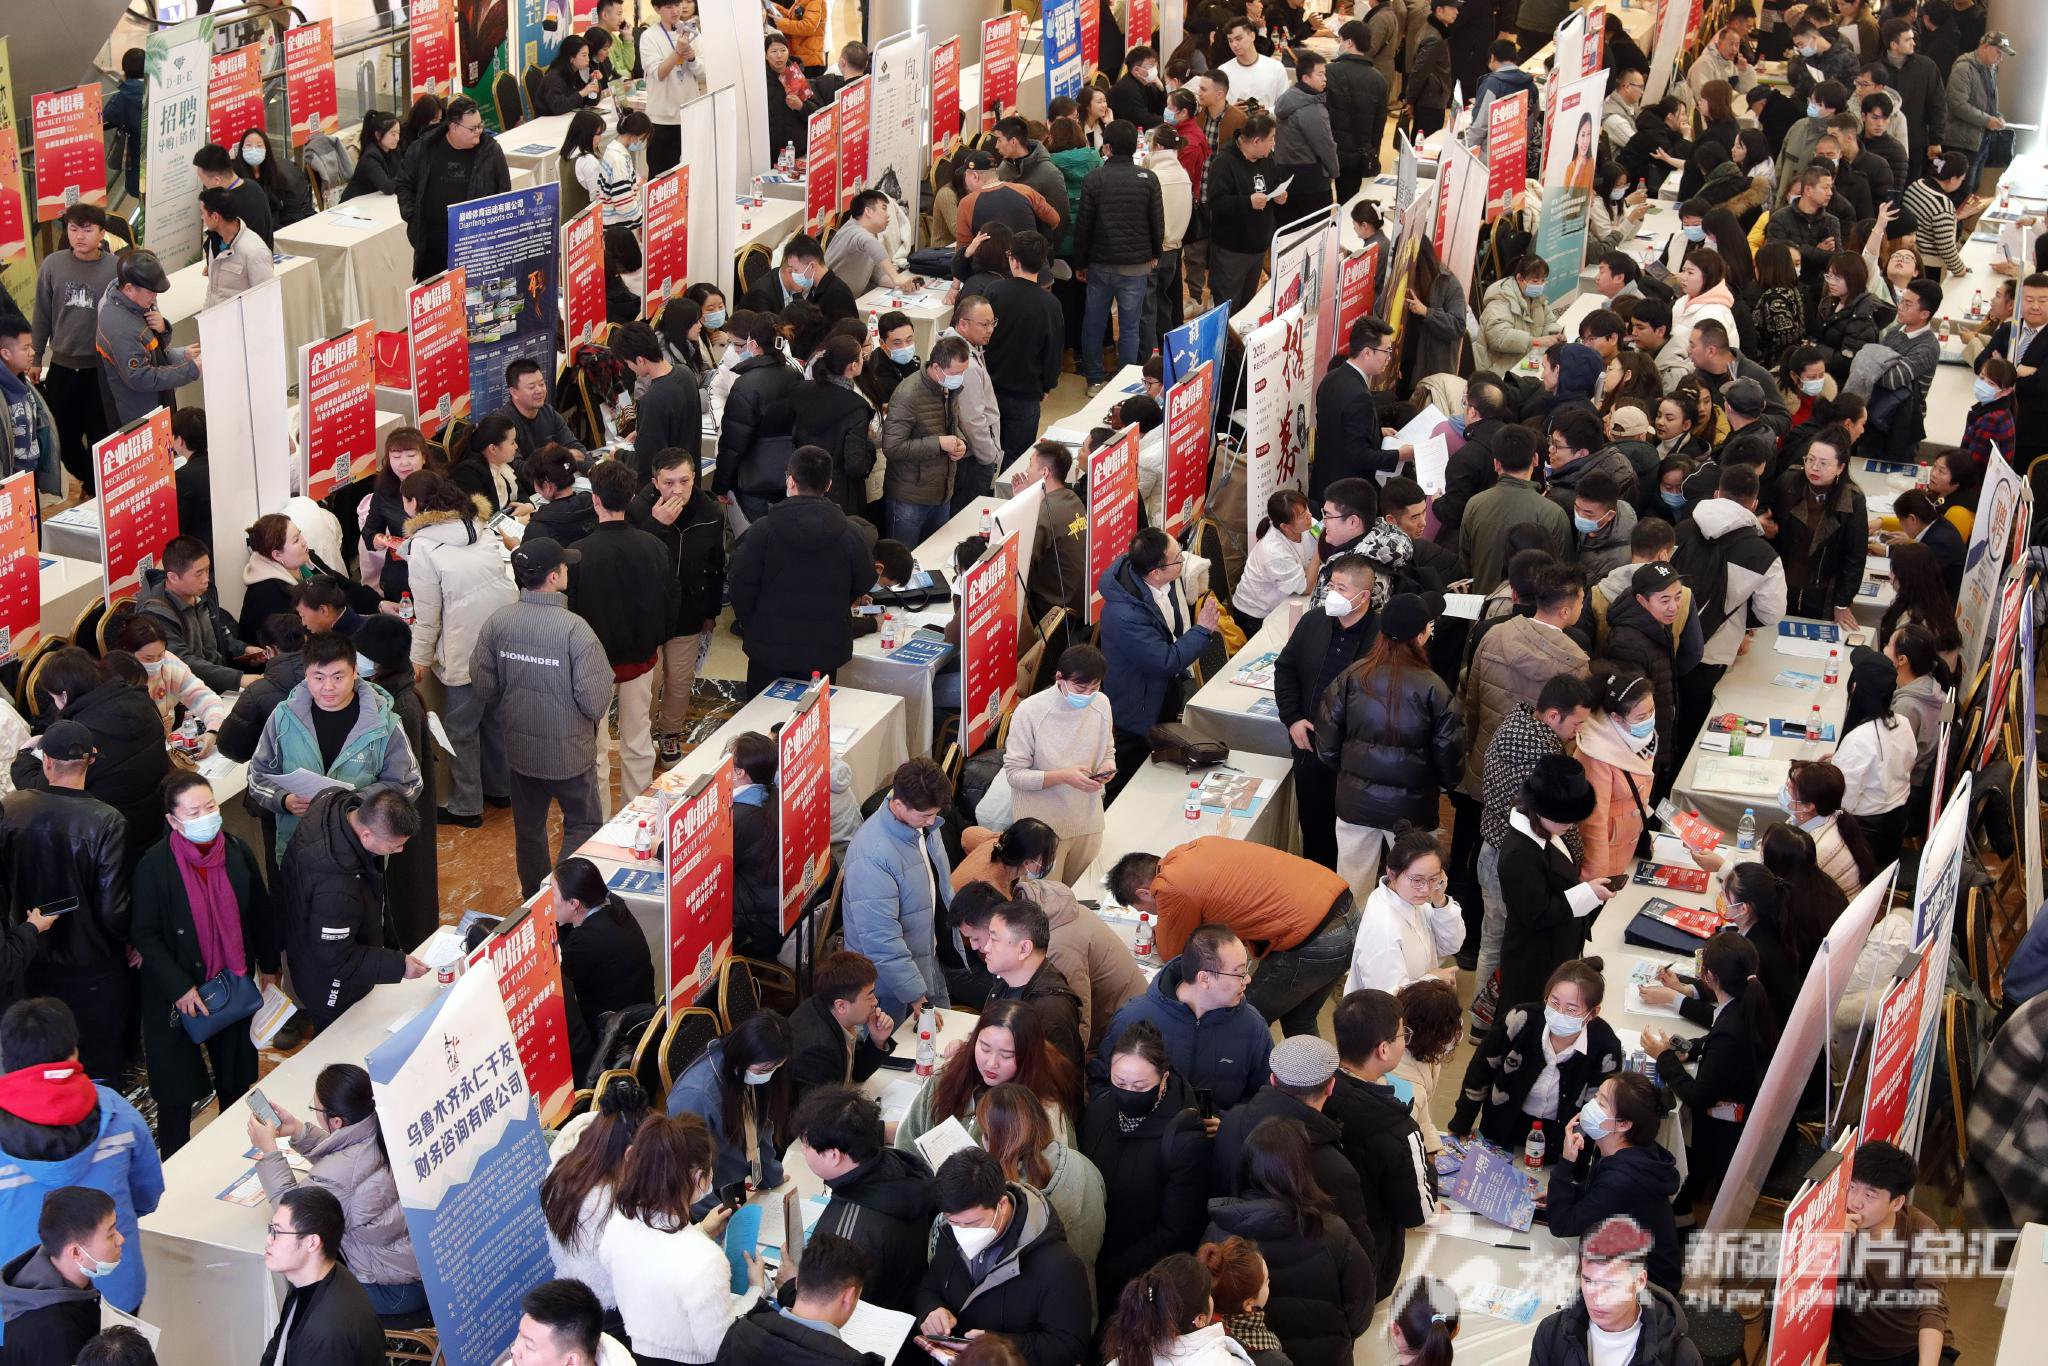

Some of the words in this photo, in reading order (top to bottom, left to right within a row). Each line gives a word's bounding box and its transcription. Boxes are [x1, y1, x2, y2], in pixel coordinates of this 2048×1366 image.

[287, 27, 321, 53] 企业招募
[1055, 8, 1076, 48] 招聘
[209, 52, 247, 81] 企业招募
[36, 92, 84, 119] 企业招募
[36, 118, 62, 130] RECRUIT
[63, 111, 85, 124] TALENT
[160, 94, 196, 136] 招聘
[648, 176, 679, 208] 企业招募
[458, 215, 486, 230] Dianfeng
[487, 211, 505, 225] sports
[568, 216, 594, 253] 企业招募
[412, 281, 451, 318] 企业招募
[311, 335, 358, 376] 企业招募
[311, 369, 335, 388] RECRUIT
[336, 359, 359, 378] TALENT
[1171, 376, 1203, 419] 企业招募
[102, 426, 153, 477] 企业招募
[104, 468, 128, 489] RECRUIT
[129, 452, 155, 476] TALENT
[1093, 441, 1129, 488] 企业招募
[968, 552, 1007, 608] 企业招募
[1653, 565, 1671, 577] LA
[783, 704, 819, 770] 企业招募
[784, 754, 804, 784] RECRUIT
[805, 734, 820, 761] TALENT
[672, 783, 719, 854] 企业招募
[672, 835, 699, 870] RECRUIT
[697, 816, 719, 845] TALENT
[544, 906, 553, 917] 69
[490, 917, 537, 978] 业招募
[511, 953, 538, 989] TALENT
[327, 988, 339, 1007] RIDE
[1880, 964, 1921, 1041] 企业招募
[407, 1041, 515, 1148] 乌鲁木齐永仁千友
[414, 1070, 523, 1183] 财务咨询有限公司
[1785, 1164, 1841, 1256] 企业招募
